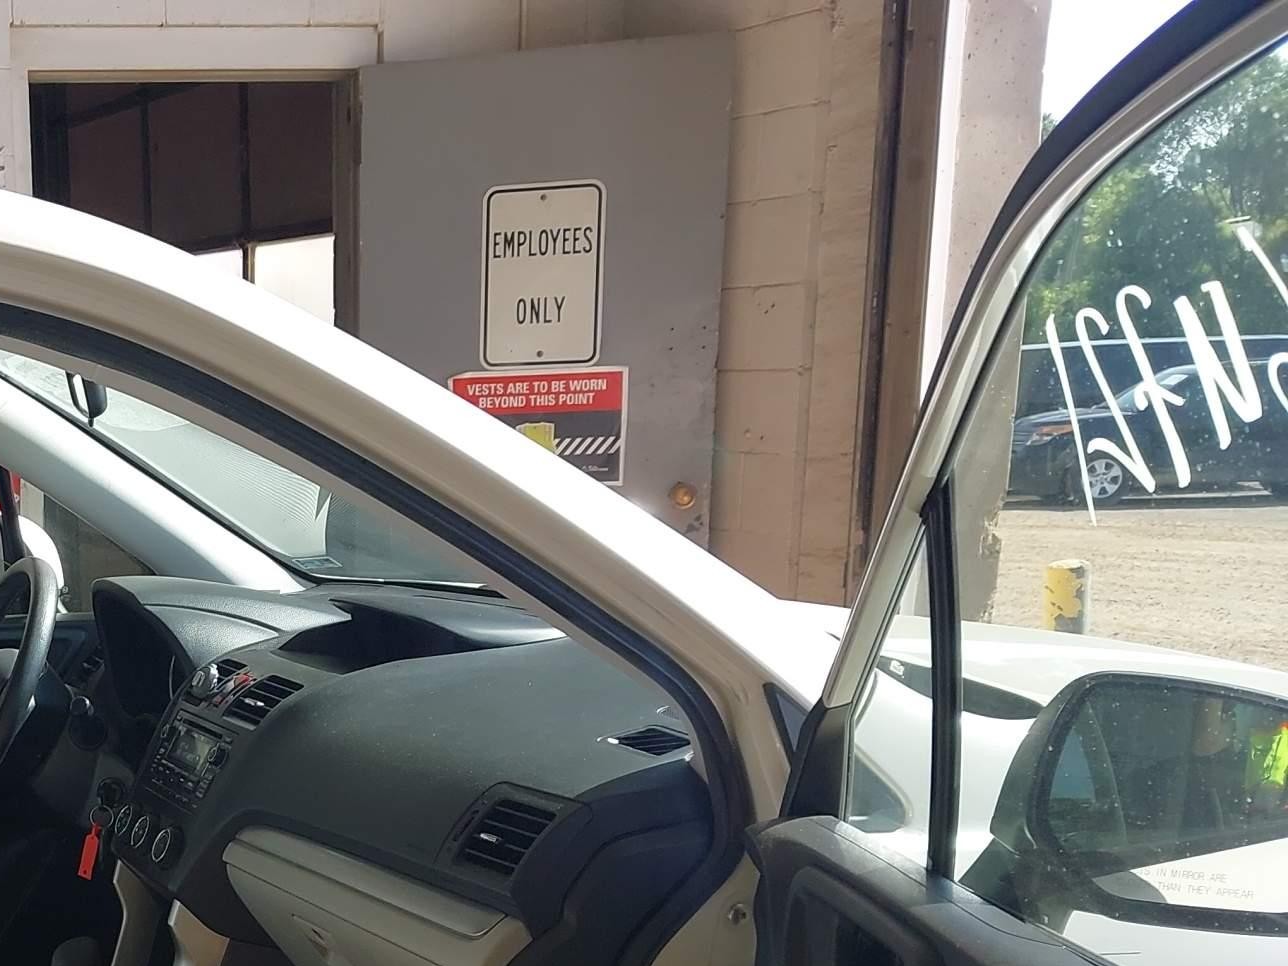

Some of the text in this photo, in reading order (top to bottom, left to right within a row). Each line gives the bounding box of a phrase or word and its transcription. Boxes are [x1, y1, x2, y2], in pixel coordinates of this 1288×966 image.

[492, 226, 594, 259] EMPLOYEES
[515, 295, 566, 325] ONLY
[467, 378, 608, 396] VESTS ARE TO BE WORN
[478, 392, 596, 409] BEYOND THIS POINT
[1156, 868, 1168, 878] IN
[1170, 869, 1205, 881] MIRROR
[1209, 872, 1229, 884] ARE
[1157, 881, 1255, 900] THAN THEY APPEAR
